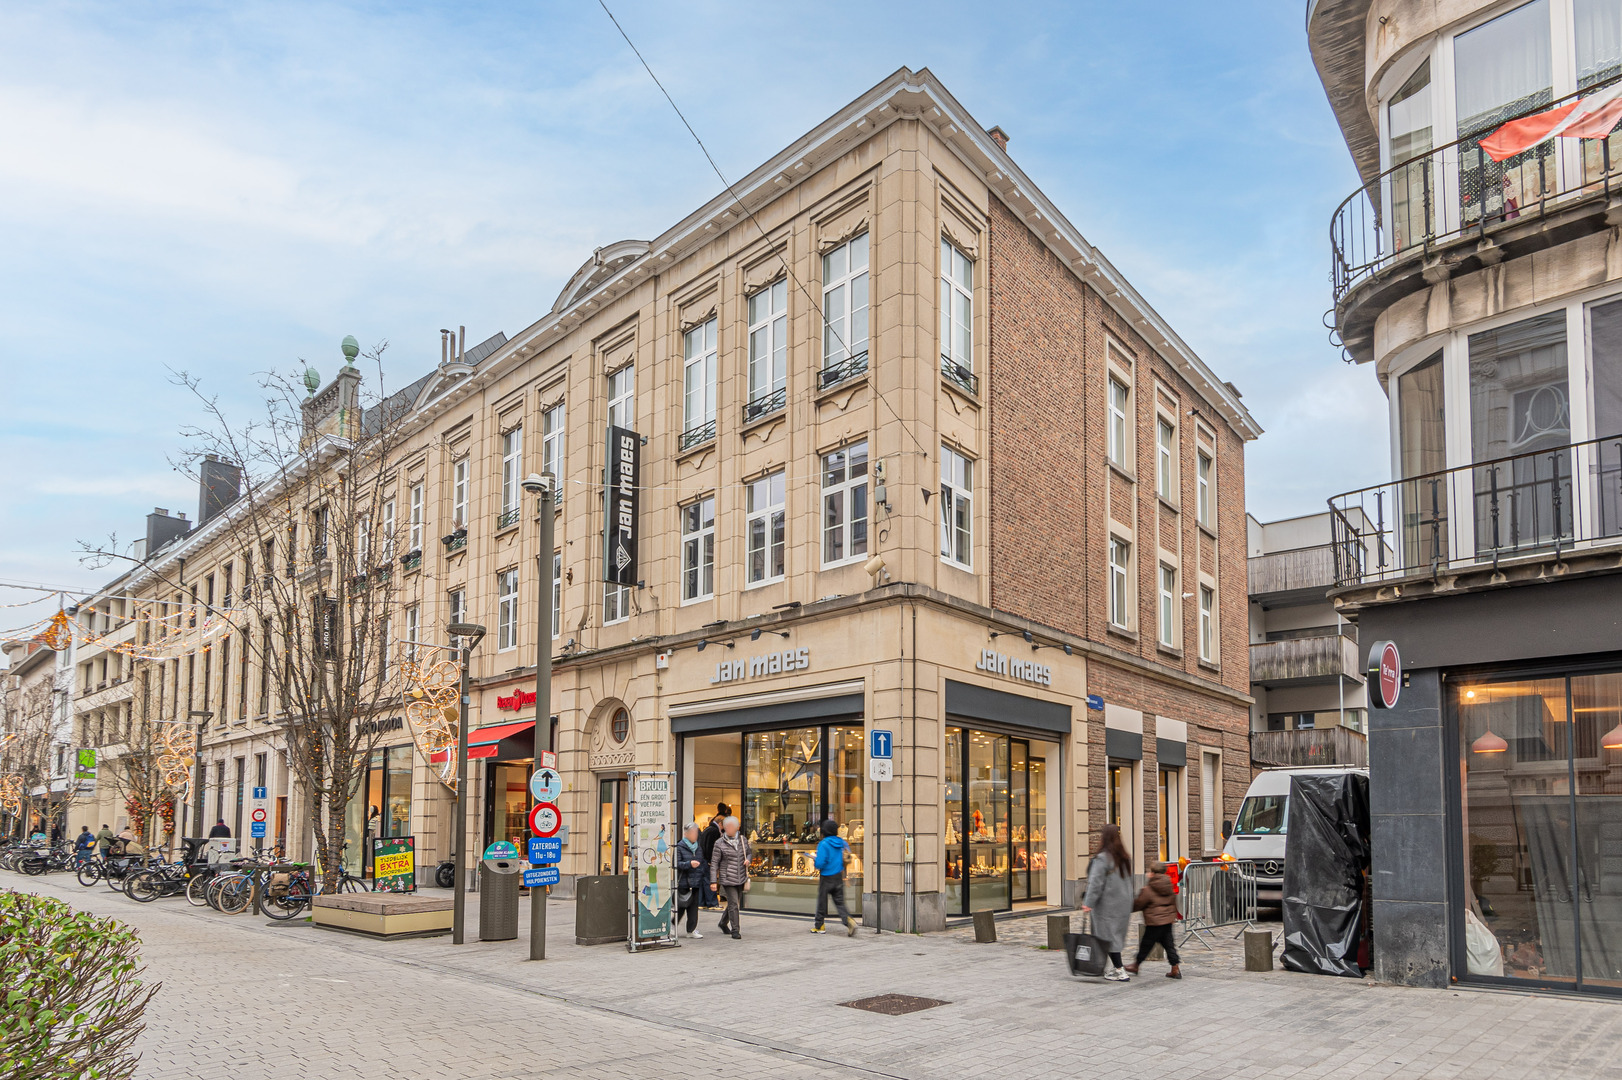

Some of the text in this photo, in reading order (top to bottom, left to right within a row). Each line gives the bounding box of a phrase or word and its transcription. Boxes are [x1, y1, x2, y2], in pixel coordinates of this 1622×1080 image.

[619, 435, 634, 497] maes
[749, 646, 809, 678] maes
[1010, 655, 1052, 686] maes
[640, 781, 667, 791] BRUUL
[651, 793, 667, 801] GROOT
[531, 842, 560, 851] ZATERDAG
[380, 854, 409, 863] TIJDELIJK
[380, 860, 410, 872] EXTRA
[525, 869, 558, 879] UITGEZONDERD
[526, 876, 558, 885] HULPDIENSTEN
[642, 927, 662, 935] MECHELEN
